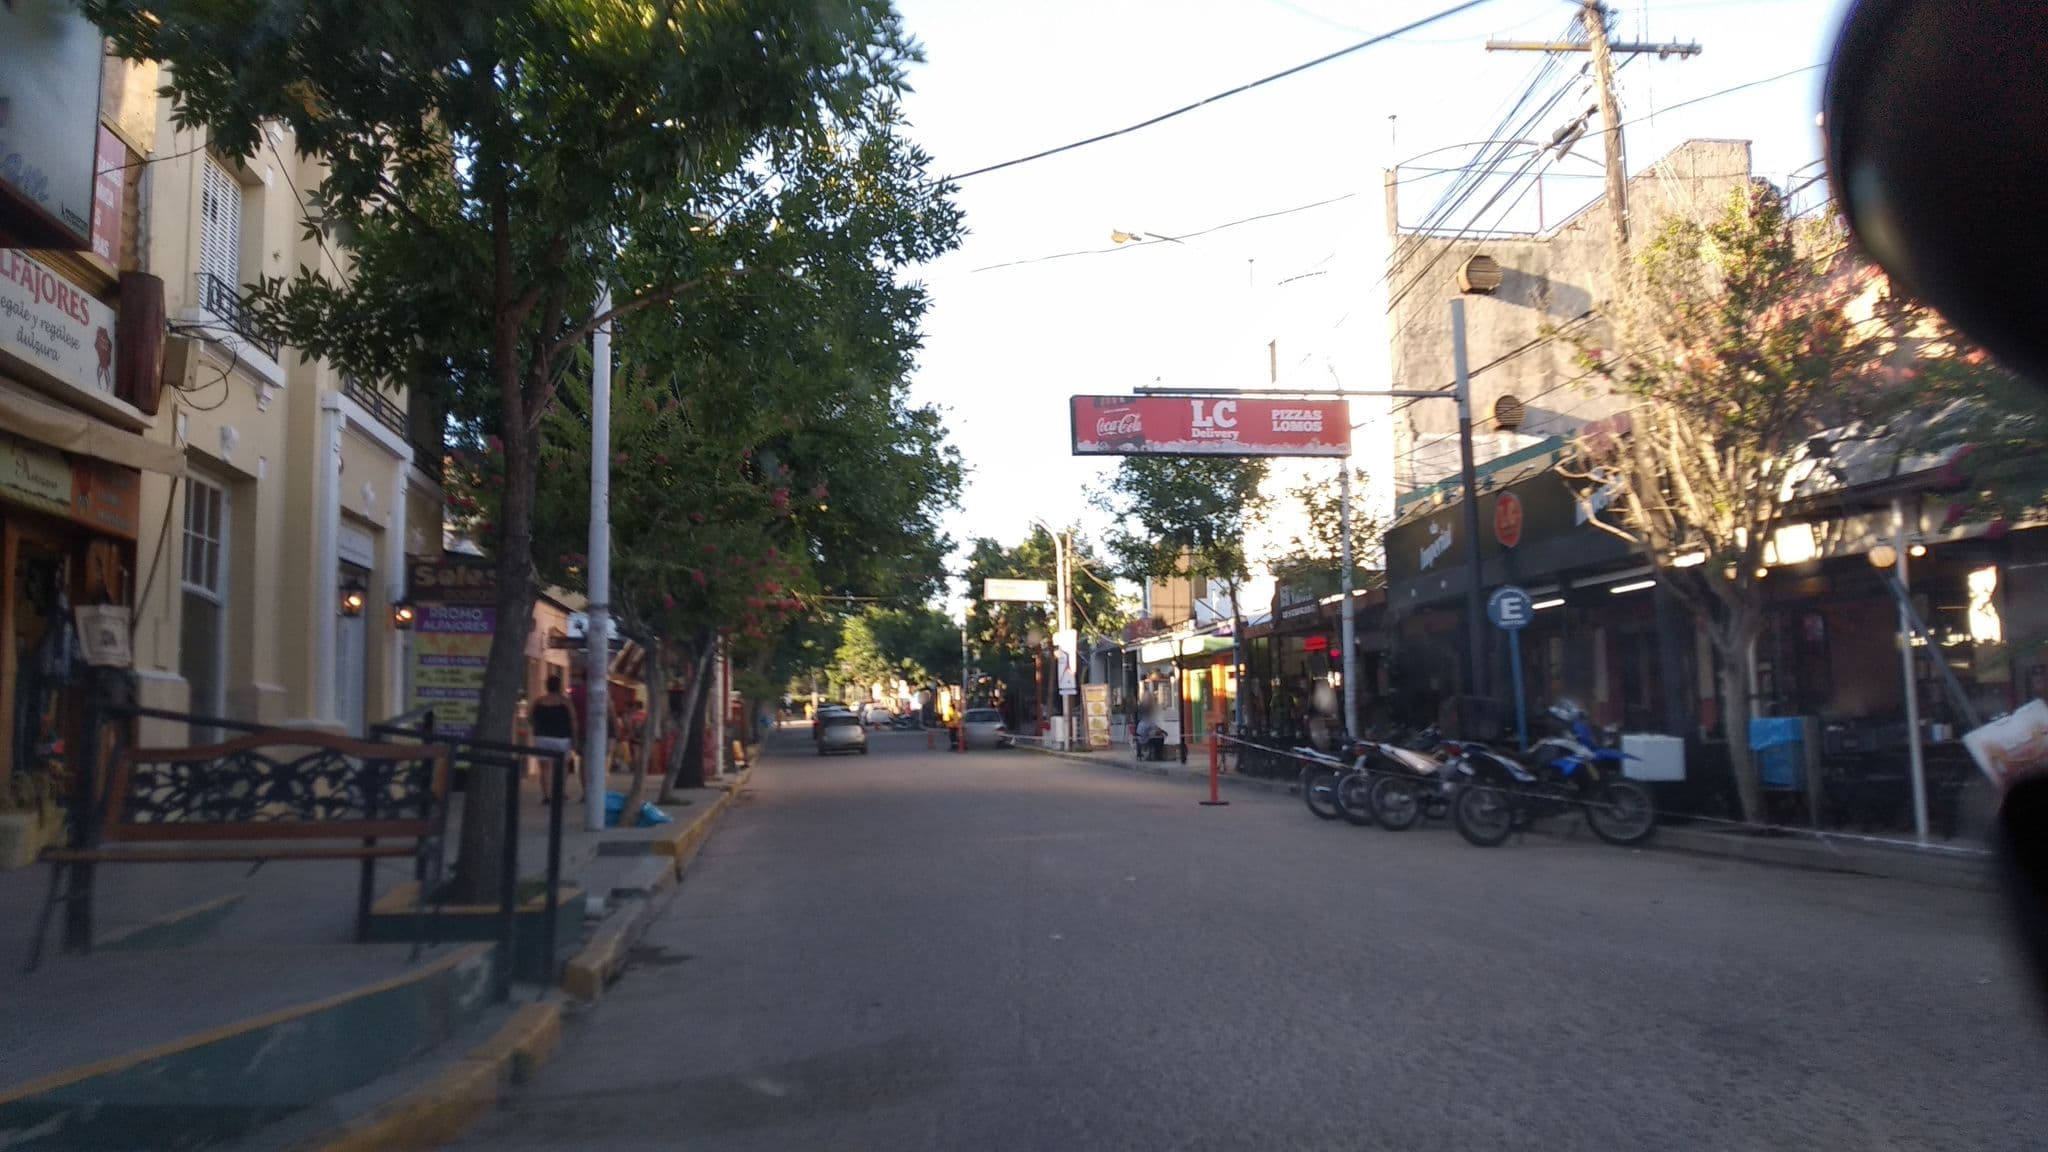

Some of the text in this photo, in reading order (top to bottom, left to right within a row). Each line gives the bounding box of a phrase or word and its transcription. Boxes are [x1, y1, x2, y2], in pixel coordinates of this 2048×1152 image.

[1191, 400, 1237, 428] LC
[1271, 410, 1322, 420] PIZZAS
[1097, 414, 1142, 436] Coca-Cola
[1272, 421, 1322, 432] LOMOS
[1191, 428, 1239, 441] Delivery
[429, 607, 482, 620] PROMO
[1500, 597, 1524, 619] E
